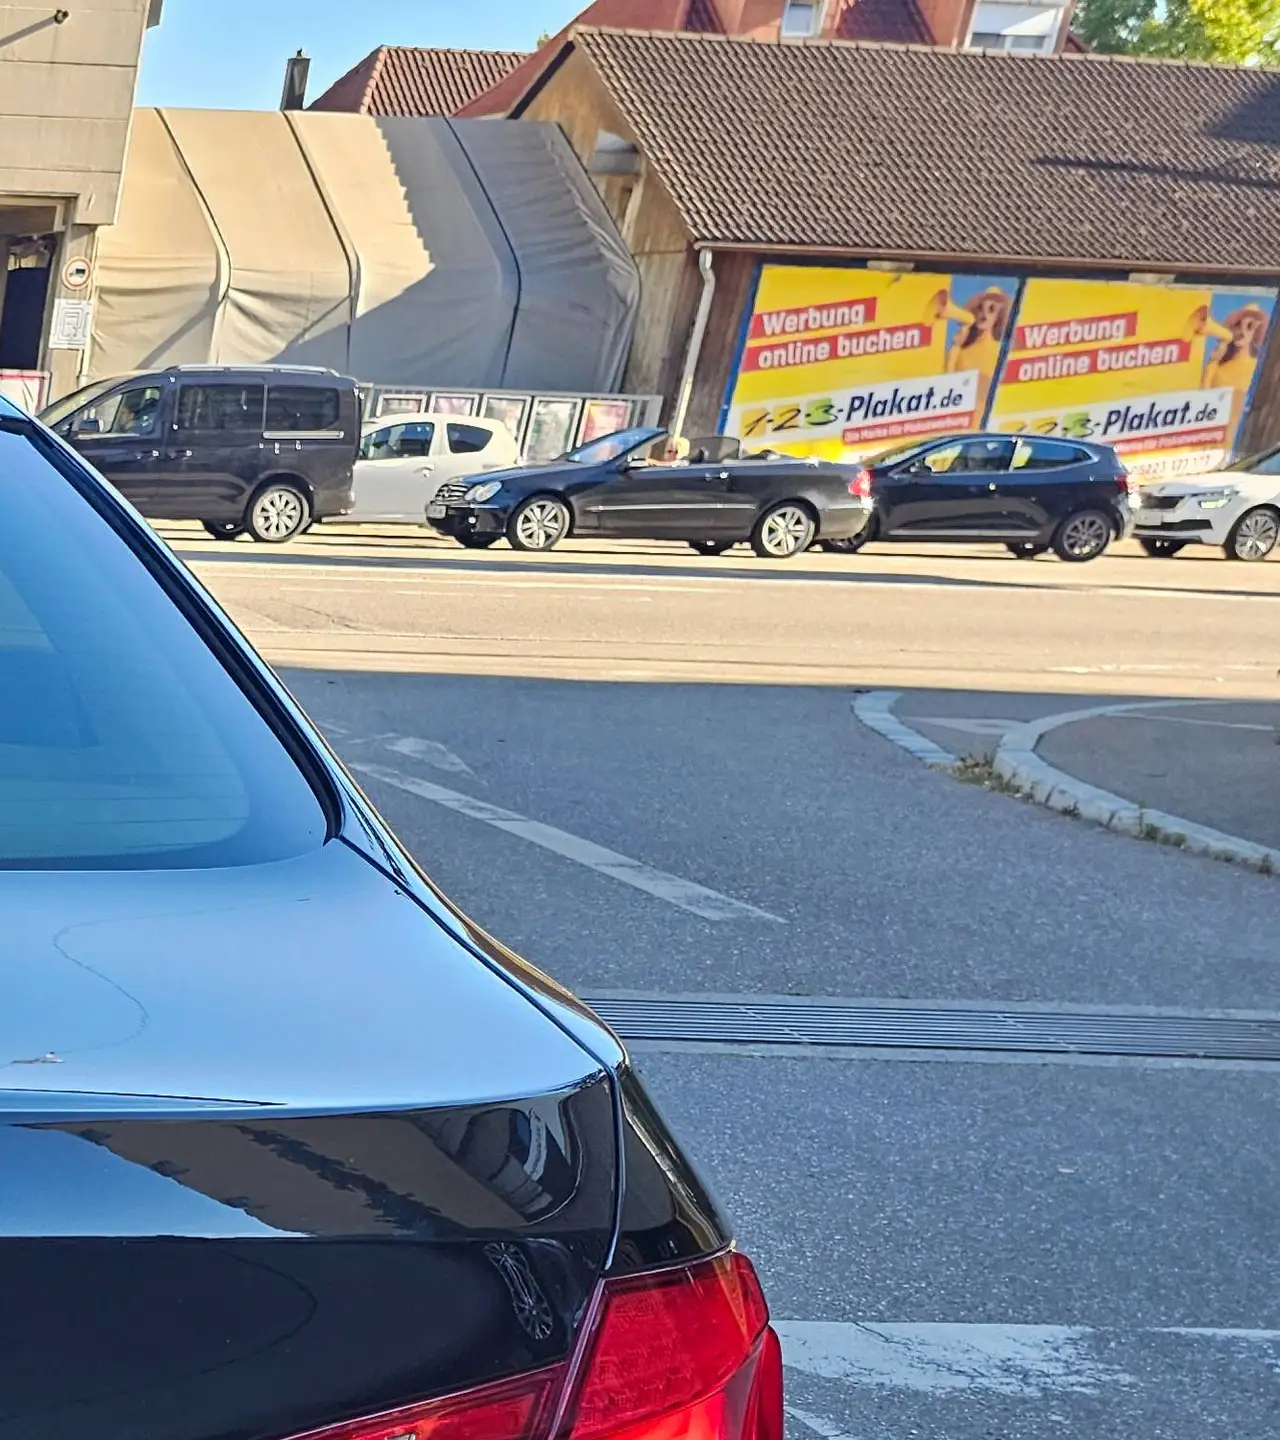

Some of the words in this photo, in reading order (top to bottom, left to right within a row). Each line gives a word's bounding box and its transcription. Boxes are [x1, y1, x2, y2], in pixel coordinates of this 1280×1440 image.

[762, 303, 866, 336] Werbung
[1024, 318, 1126, 348] Werbung
[758, 342, 830, 368] online
[837, 327, 920, 356] buchen
[1018, 356, 1090, 381] online
[1097, 343, 1179, 371] buchen
